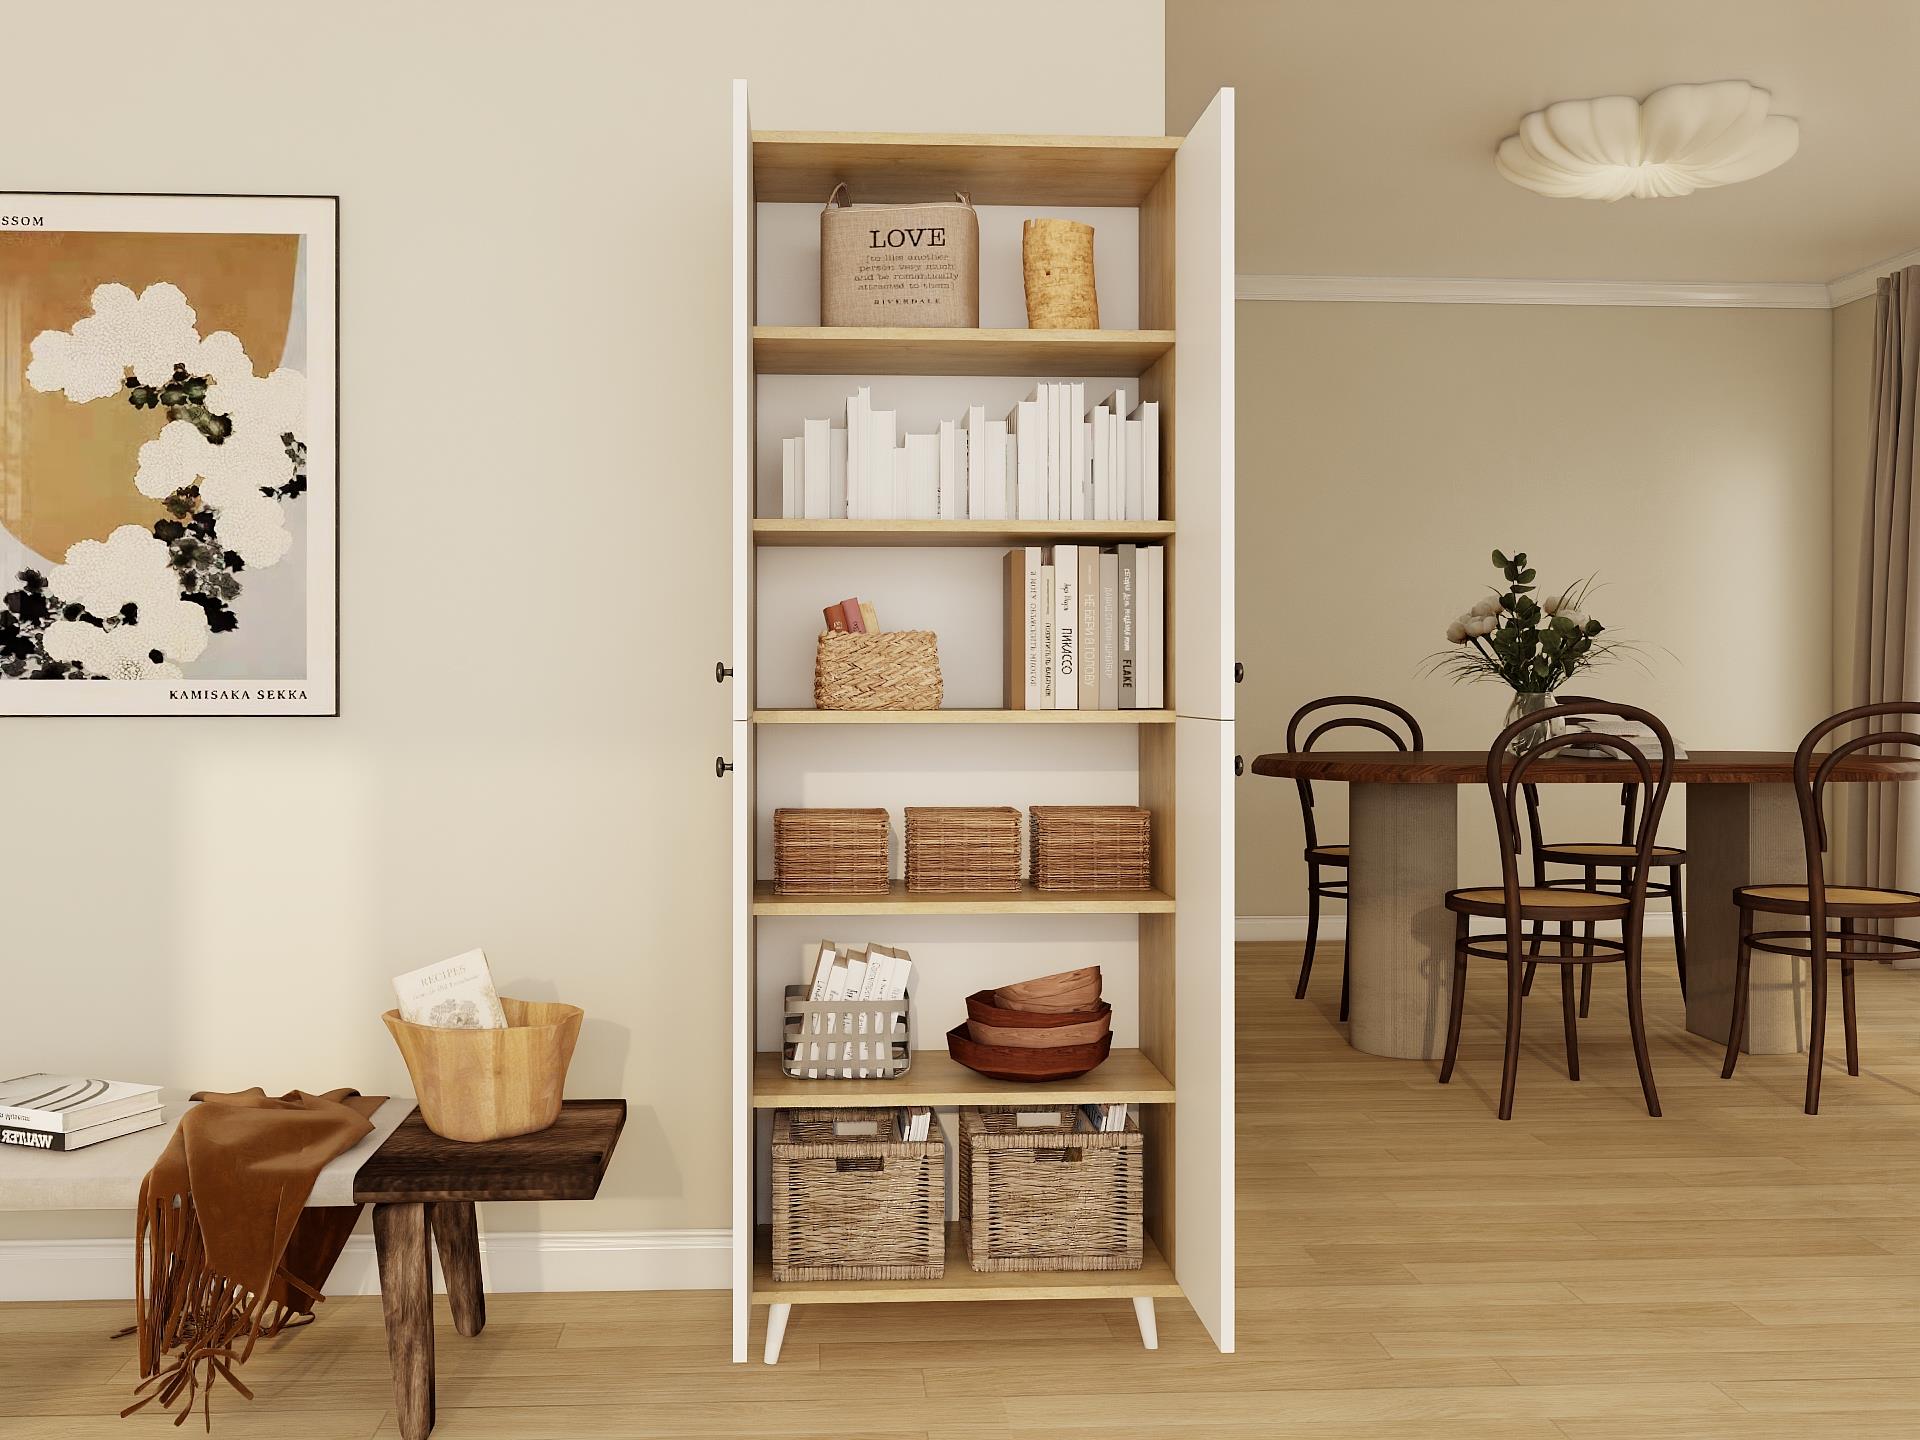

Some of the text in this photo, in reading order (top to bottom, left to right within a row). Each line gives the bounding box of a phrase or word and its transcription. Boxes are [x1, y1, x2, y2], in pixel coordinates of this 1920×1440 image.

[1, 215, 44, 226] SSOM
[868, 227, 946, 249] LOVE
[907, 253, 949, 262] another
[859, 265, 895, 273] person
[854, 274, 874, 282] and
[877, 273, 890, 281] be
[1061, 628, 1073, 675] ПИКАССО
[1122, 659, 1133, 688] FLAKE
[169, 689, 308, 700] KAMISAKA SEKKA
[421, 967, 466, 987] RECIPES
